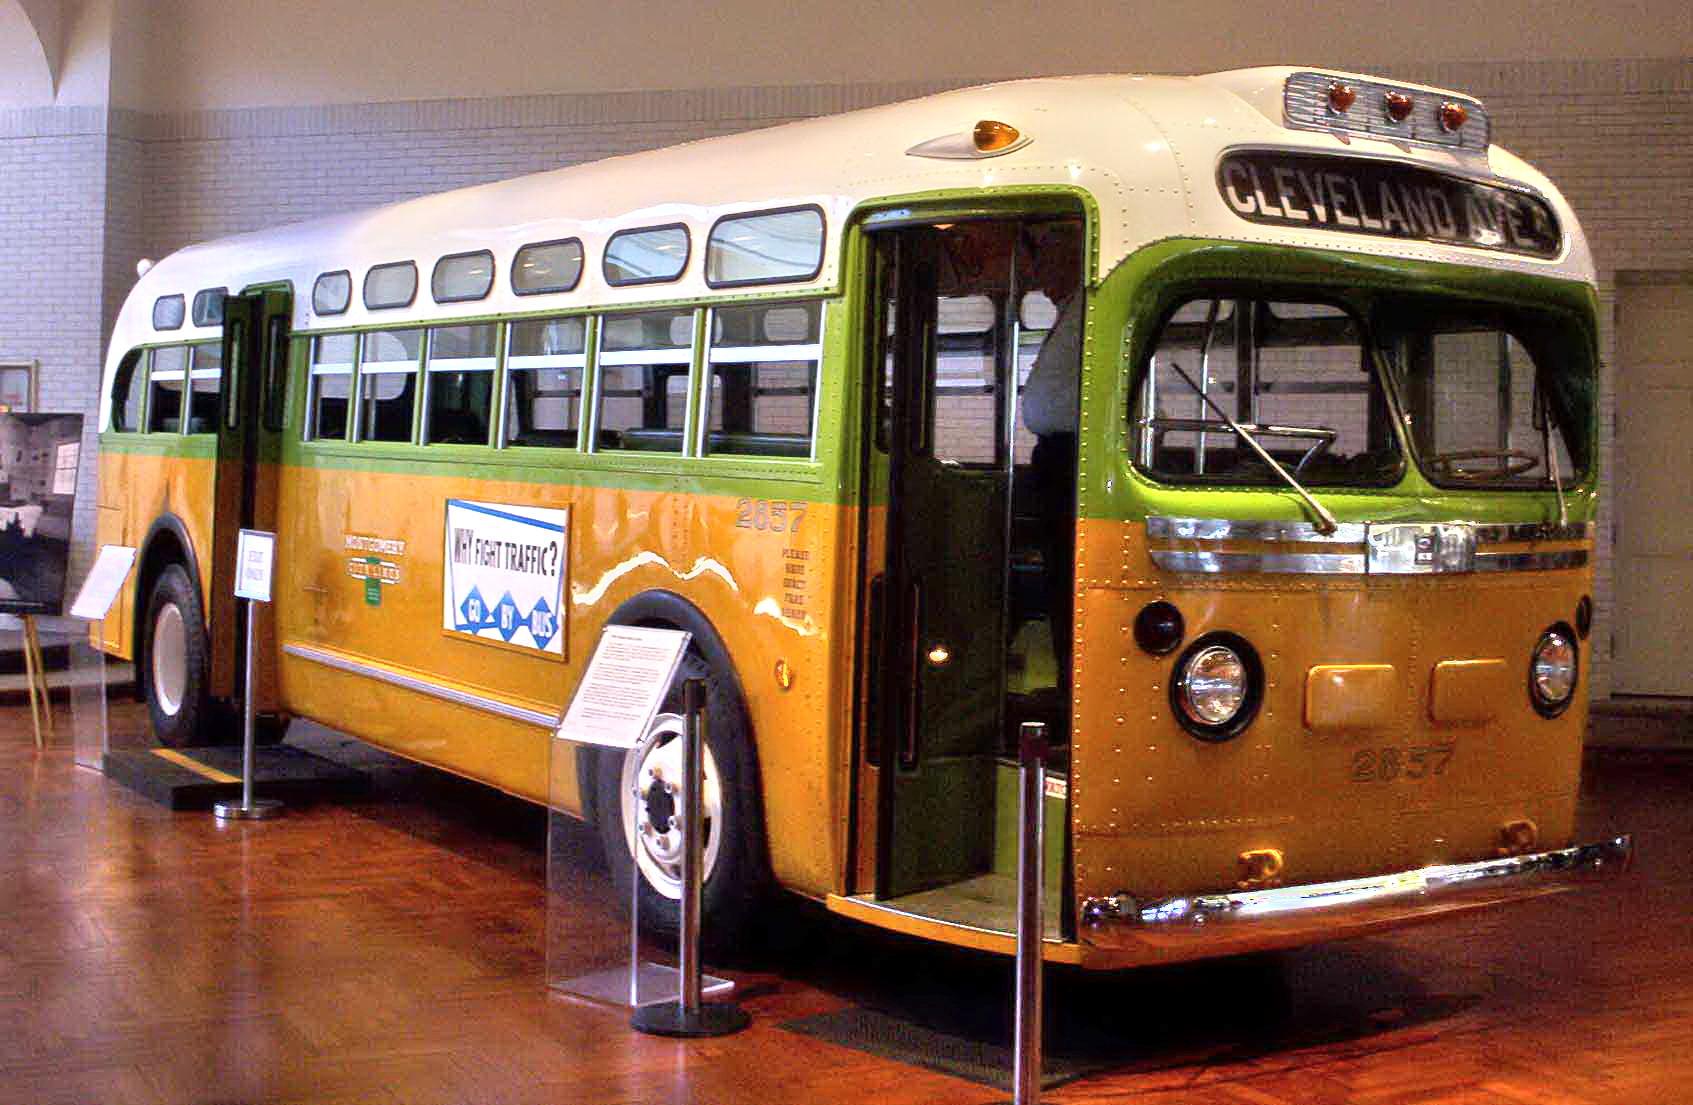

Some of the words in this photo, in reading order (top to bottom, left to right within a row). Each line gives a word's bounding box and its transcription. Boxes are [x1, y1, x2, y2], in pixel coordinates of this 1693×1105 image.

[1224, 159, 1455, 238] CLEVELAND
[735, 497, 809, 532] 2857
[454, 528, 474, 565] WHY
[475, 538, 501, 569] FIGHT
[505, 540, 558, 577] TRAFFIC?
[468, 598, 482, 624] GO
[502, 603, 514, 631] BY
[531, 609, 554, 638] BUS
[1350, 743, 1454, 784] 2857
